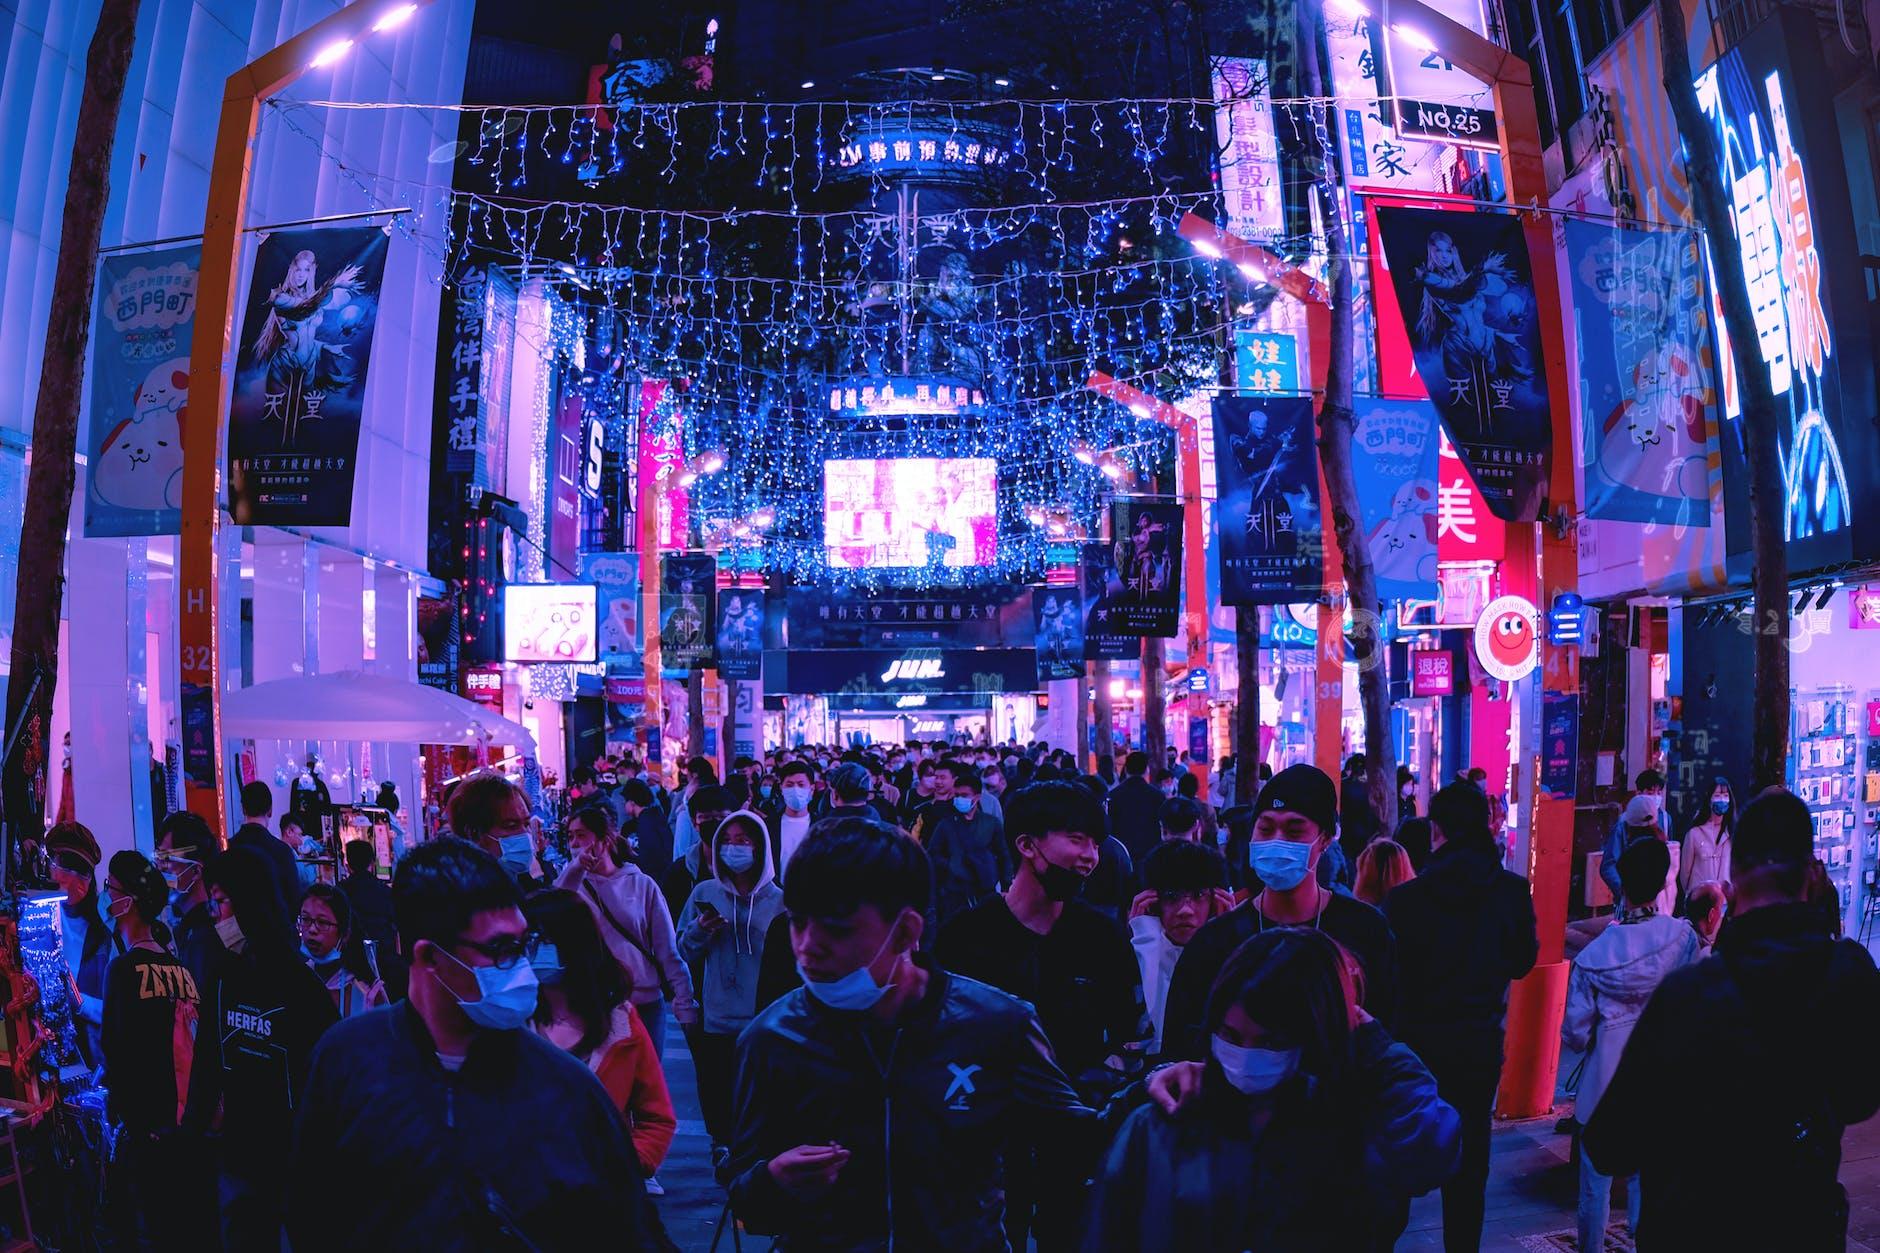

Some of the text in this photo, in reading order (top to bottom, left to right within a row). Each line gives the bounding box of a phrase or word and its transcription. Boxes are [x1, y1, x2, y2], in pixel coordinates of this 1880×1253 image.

[1418, 108, 1482, 134] NO.25
[116, 289, 193, 322] 西門町
[1247, 338, 1288, 396] 娃娃
[1365, 427, 1427, 449] 西門町
[187, 588, 205, 613] H
[898, 604, 999, 620] 才能超越天堂
[183, 645, 211, 671] 32
[1417, 657, 1449, 676] 退稅
[226, 1009, 273, 1037] HERFAS
